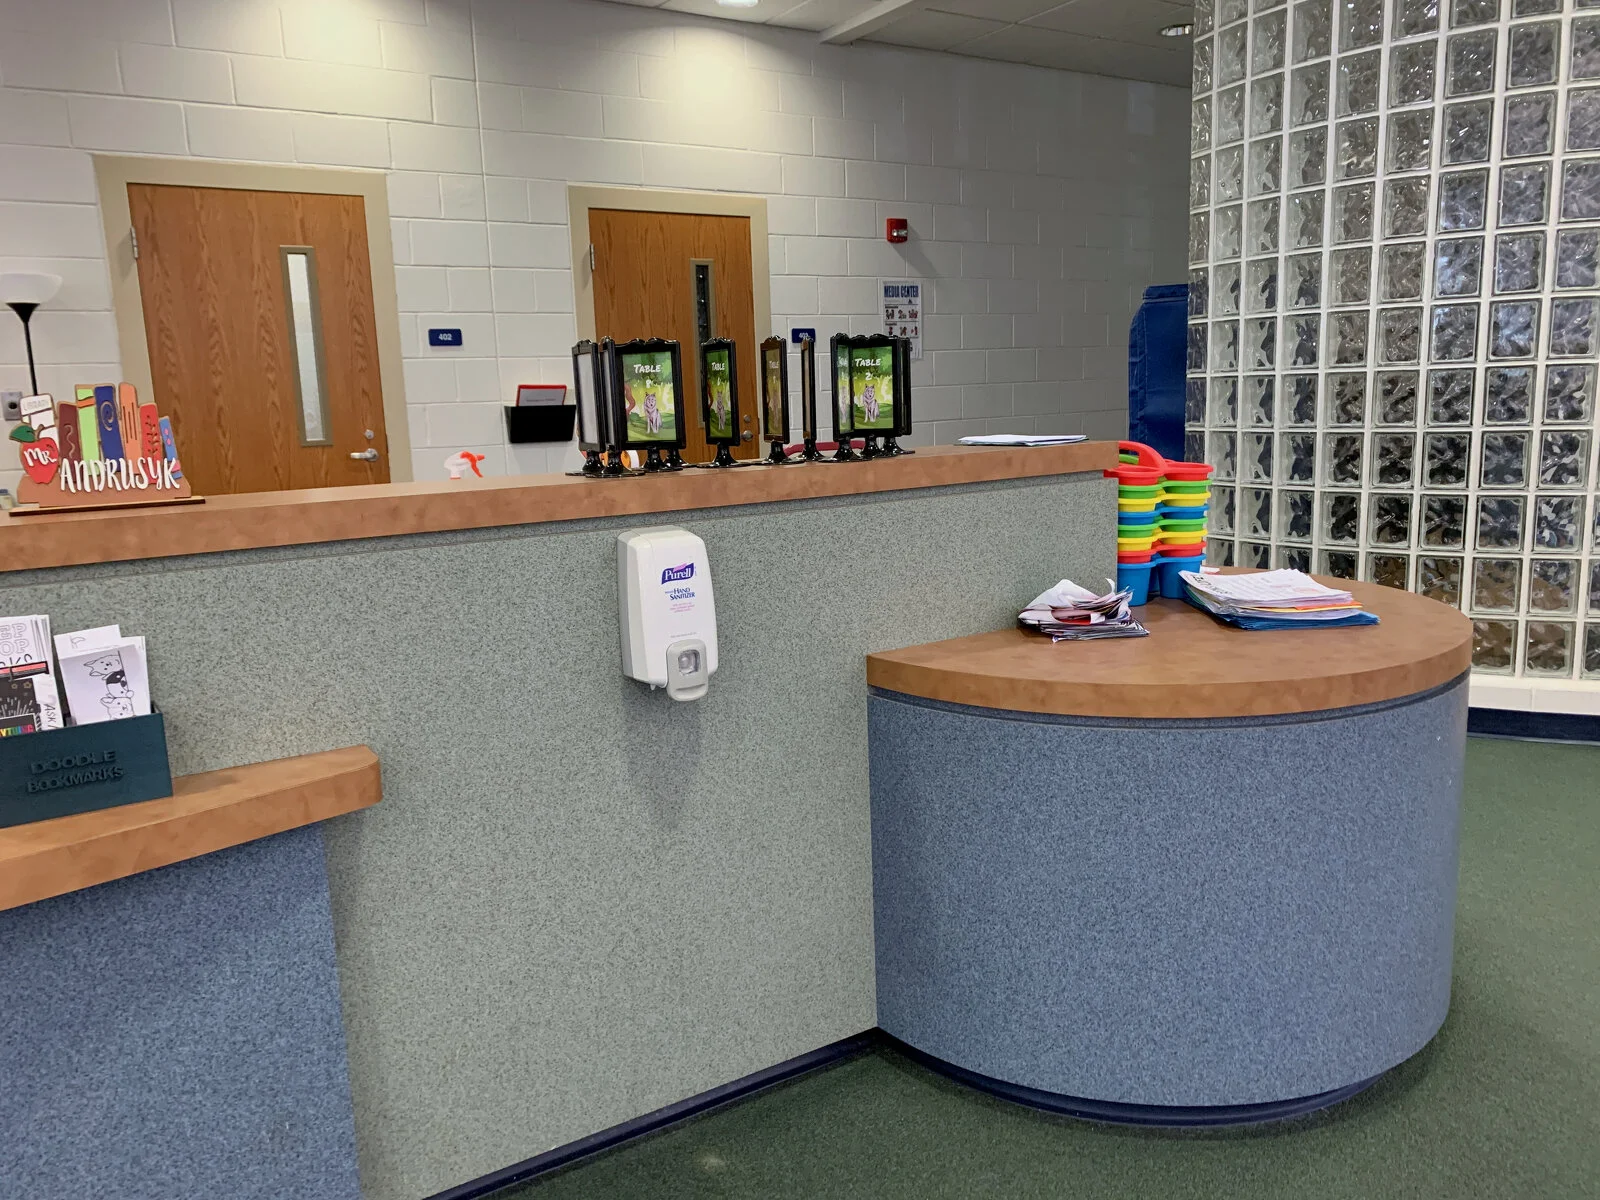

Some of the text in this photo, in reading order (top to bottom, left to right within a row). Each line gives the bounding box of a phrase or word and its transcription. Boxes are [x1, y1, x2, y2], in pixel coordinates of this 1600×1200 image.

[884, 285, 919, 298] MEDIA CENTER
[711, 362, 725, 371] TABLE
[855, 358, 881, 366] TABLE
[633, 363, 662, 373] TABLE
[865, 372, 872, 381] 2
[60, 457, 180, 493] ANDRUSYK
[670, 592, 695, 600] SANITIZER
[31, 750, 117, 774] DOODLE
[27, 766, 124, 793] BOOKMARKS
